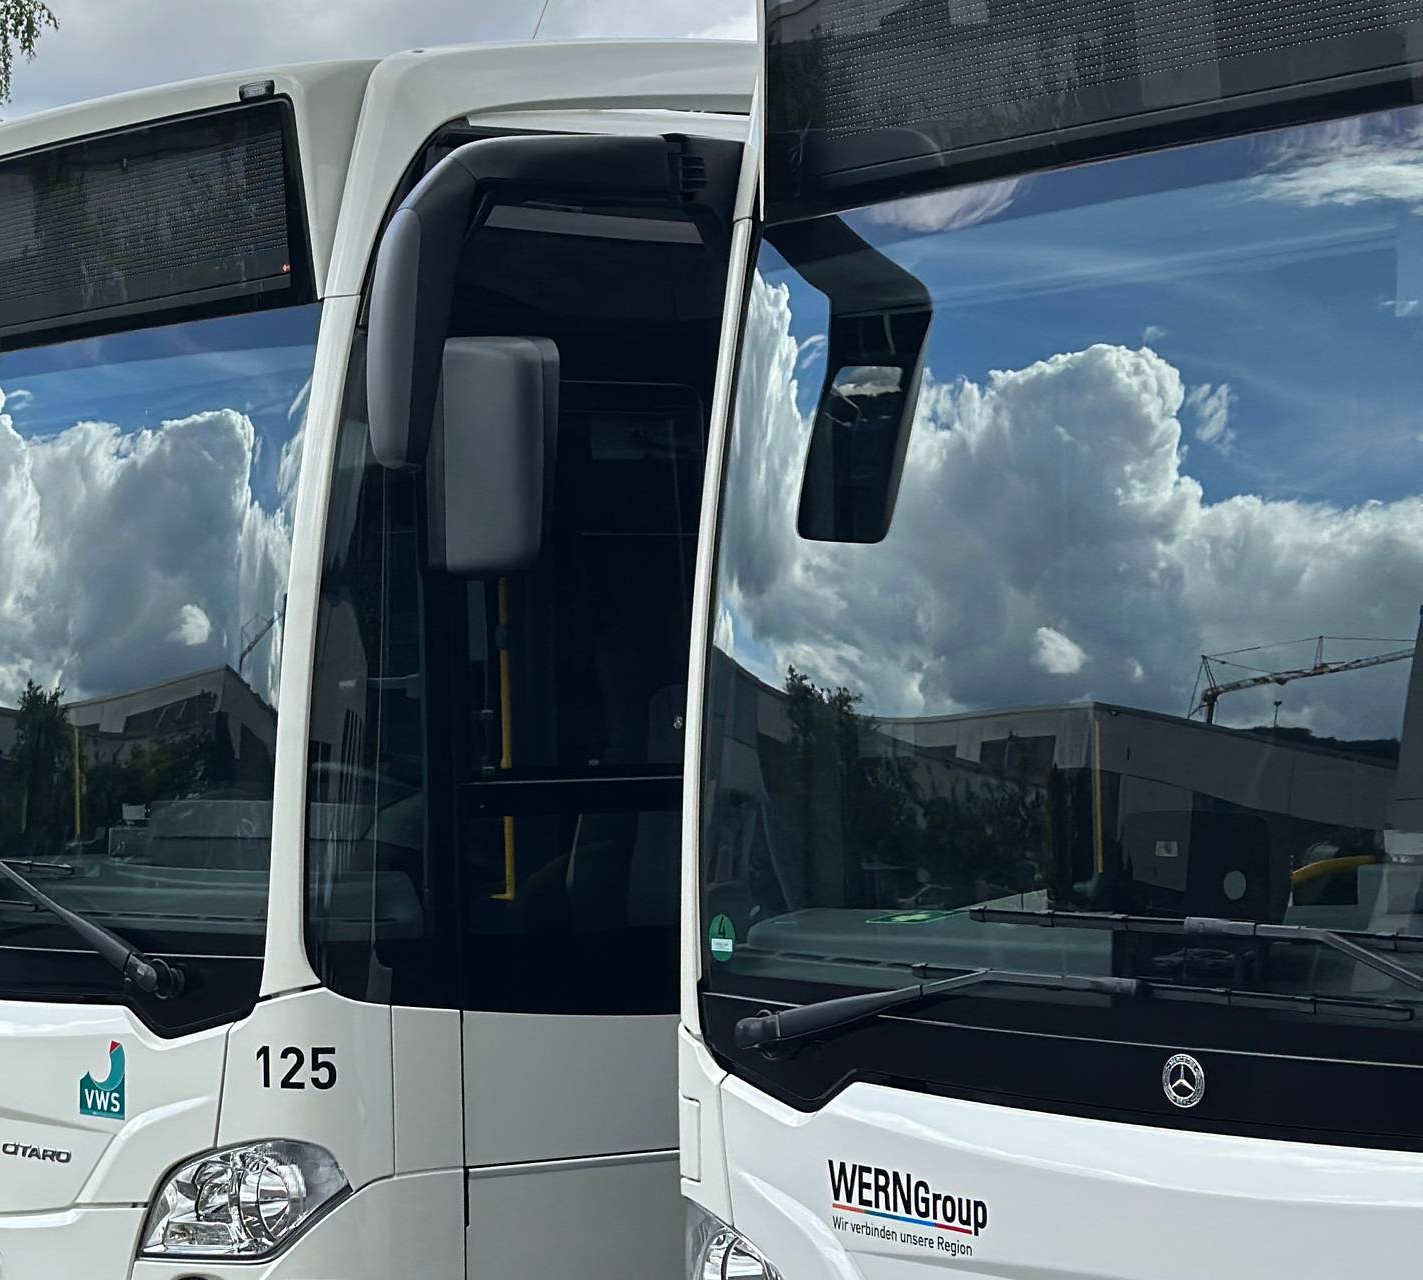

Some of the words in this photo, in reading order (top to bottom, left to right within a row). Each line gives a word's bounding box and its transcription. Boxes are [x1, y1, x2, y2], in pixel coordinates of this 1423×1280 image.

[256, 1045, 338, 1090] 125
[84, 1088, 122, 1113] VWS
[2, 1142, 72, 1164] CITARO
[828, 1159, 988, 1236] WERNGroup
[832, 1215, 849, 1231] Wir
[851, 1222, 898, 1242] verbinden
[900, 1231, 935, 1249] unsere
[937, 1236, 973, 1257] Region
